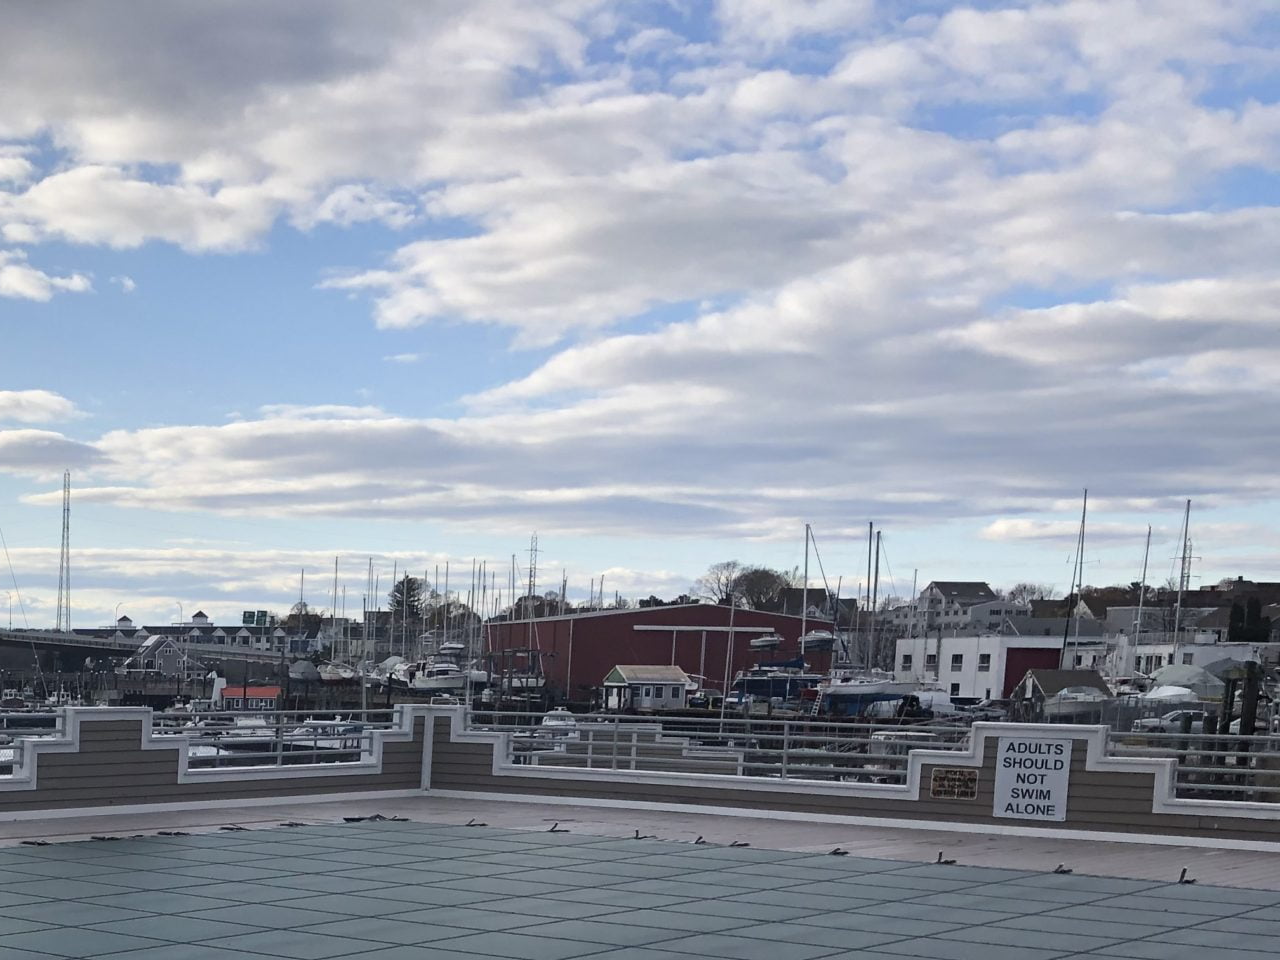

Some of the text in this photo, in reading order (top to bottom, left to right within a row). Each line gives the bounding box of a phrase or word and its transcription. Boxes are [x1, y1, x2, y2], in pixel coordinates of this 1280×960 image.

[1006, 742, 1064, 755] ADULTS
[1003, 757, 1064, 771] SHOULD
[1016, 773, 1047, 785] NOT
[1011, 788, 1051, 801] SWIM
[1004, 803, 1055, 816] ALONE
